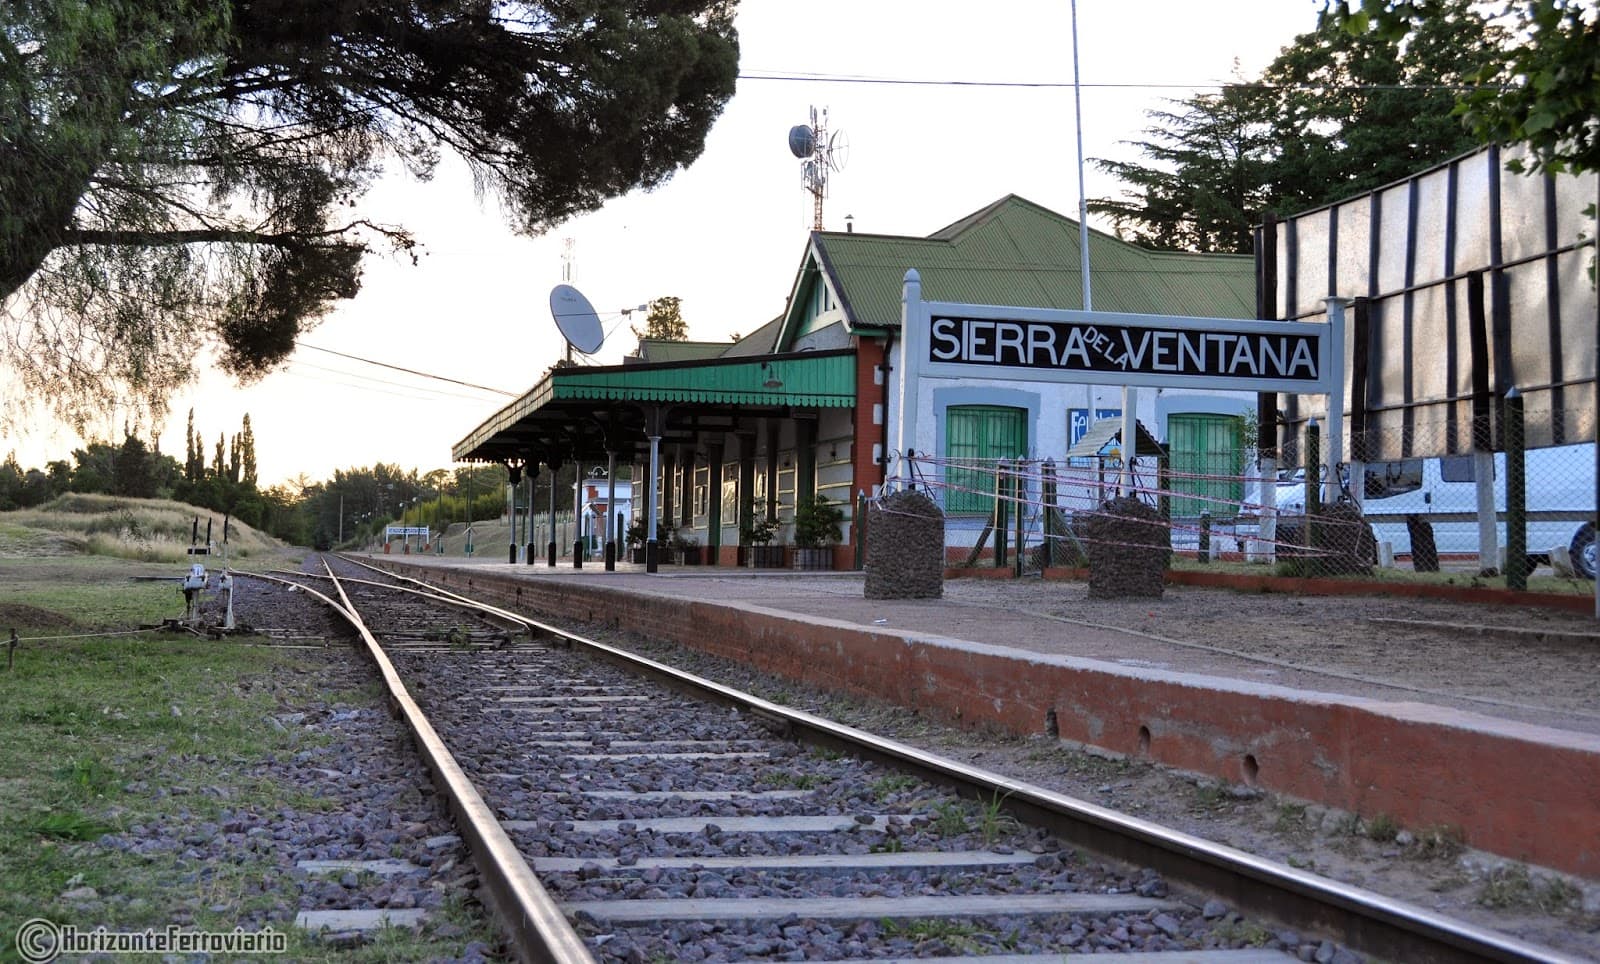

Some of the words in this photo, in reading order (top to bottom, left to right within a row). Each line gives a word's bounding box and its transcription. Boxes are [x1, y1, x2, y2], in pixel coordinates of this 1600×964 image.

[932, 319, 1091, 367] SIERRA
[1083, 325, 1109, 353] DE
[1103, 342, 1128, 371] LA
[1121, 329, 1318, 377] VENTANA
